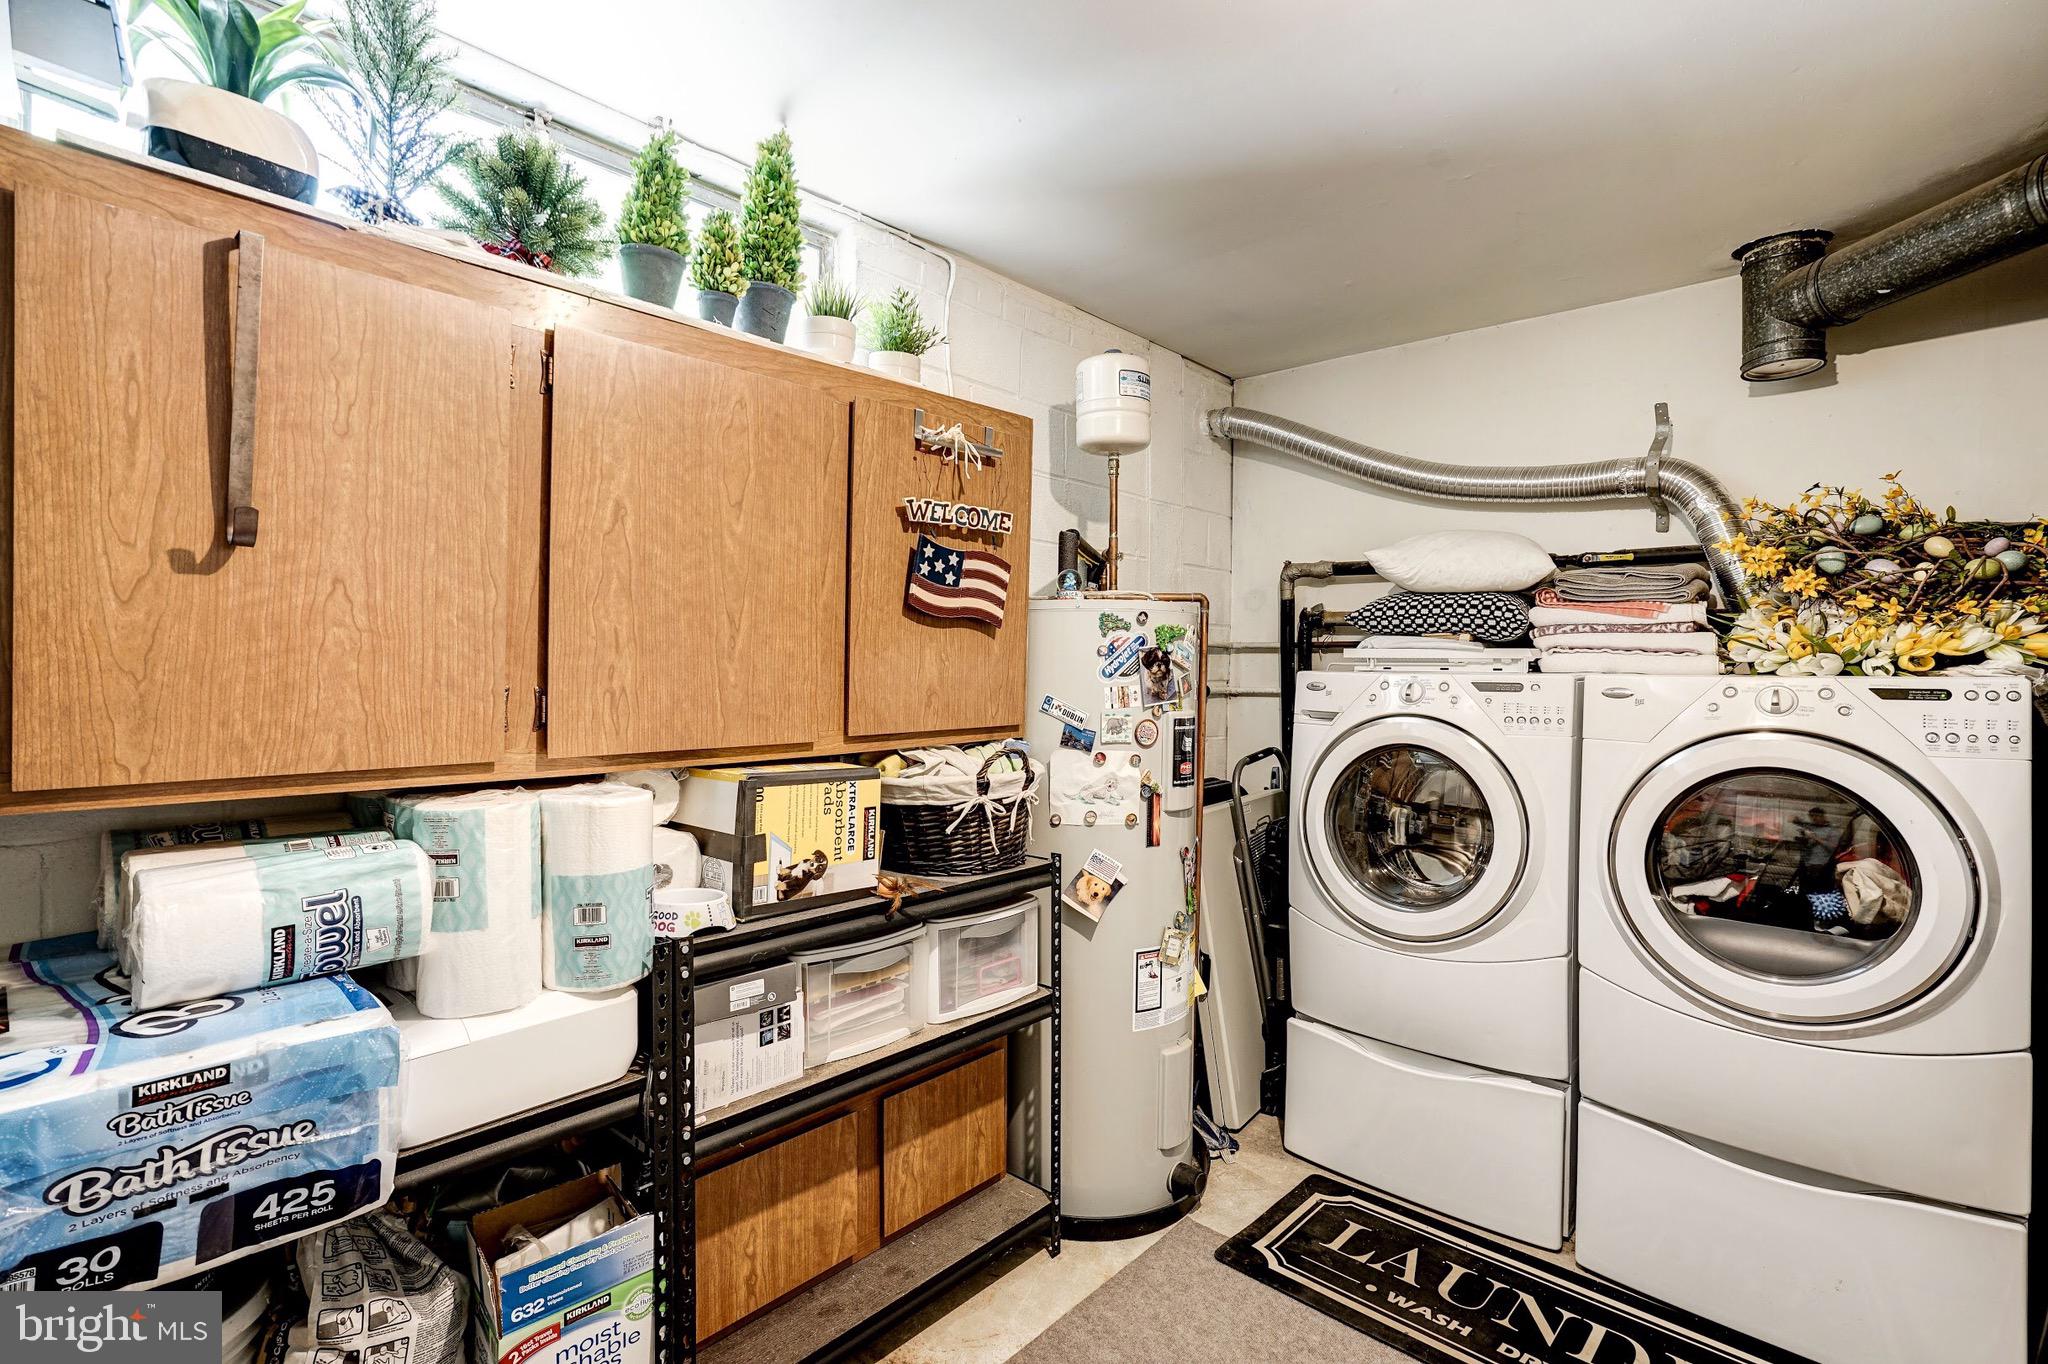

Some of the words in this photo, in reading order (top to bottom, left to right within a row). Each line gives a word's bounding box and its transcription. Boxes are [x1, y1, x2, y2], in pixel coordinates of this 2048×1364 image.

[904, 498, 1012, 533] WELCOME
[1062, 708, 1085, 725] DUBLIN
[847, 781, 857, 852] XTRA-LARGE
[867, 808, 876, 859] KIRKLAND
[352, 897, 361, 930] Absorbent
[652, 910, 679, 920] GOOD
[272, 928, 286, 980] KIRKLAND
[352, 943, 360, 958] Thick
[138, 1067, 227, 1098] KIRKLAND
[124, 1134, 148, 1146] Layers
[158, 1124, 188, 1136] Softness
[203, 1110, 242, 1126] Absorbency
[67, 1223, 79, 1233] 2
[81, 1208, 127, 1230] Layers
[130, 1203, 145, 1215] of
[149, 1182, 204, 1207] Softness
[206, 1172, 230, 1190] and
[232, 1151, 302, 1179] Absorbency
[252, 1179, 337, 1221] 425
[254, 1215, 290, 1232] SHEETS
[291, 1210, 310, 1221] PER
[310, 1203, 335, 1216] ROLL
[55, 1246, 121, 1286] 30
[518, 1278, 542, 1294] Better
[542, 1267, 570, 1285] cleaning
[570, 1261, 586, 1273] than
[585, 1255, 599, 1268] dry
[633, 1233, 649, 1246] alone
[528, 1259, 566, 1282] Enhanced
[566, 1247, 601, 1268] Cleansing
[607, 1231, 641, 1252] Freshness
[547, 1281, 583, 1302] Premoistened
[565, 1295, 610, 1321] KIRKLAND
[1319, 1219, 1693, 1364] LAUND
[510, 1297, 546, 1323] 632
[1386, 1290, 1473, 1338] WASH
[521, 1342, 540, 1357] Packs
[539, 1332, 558, 1345] Inside
[533, 1328, 554, 1342] Travel
[555, 1321, 621, 1364] moist
[1496, 1342, 1552, 1364] DR
